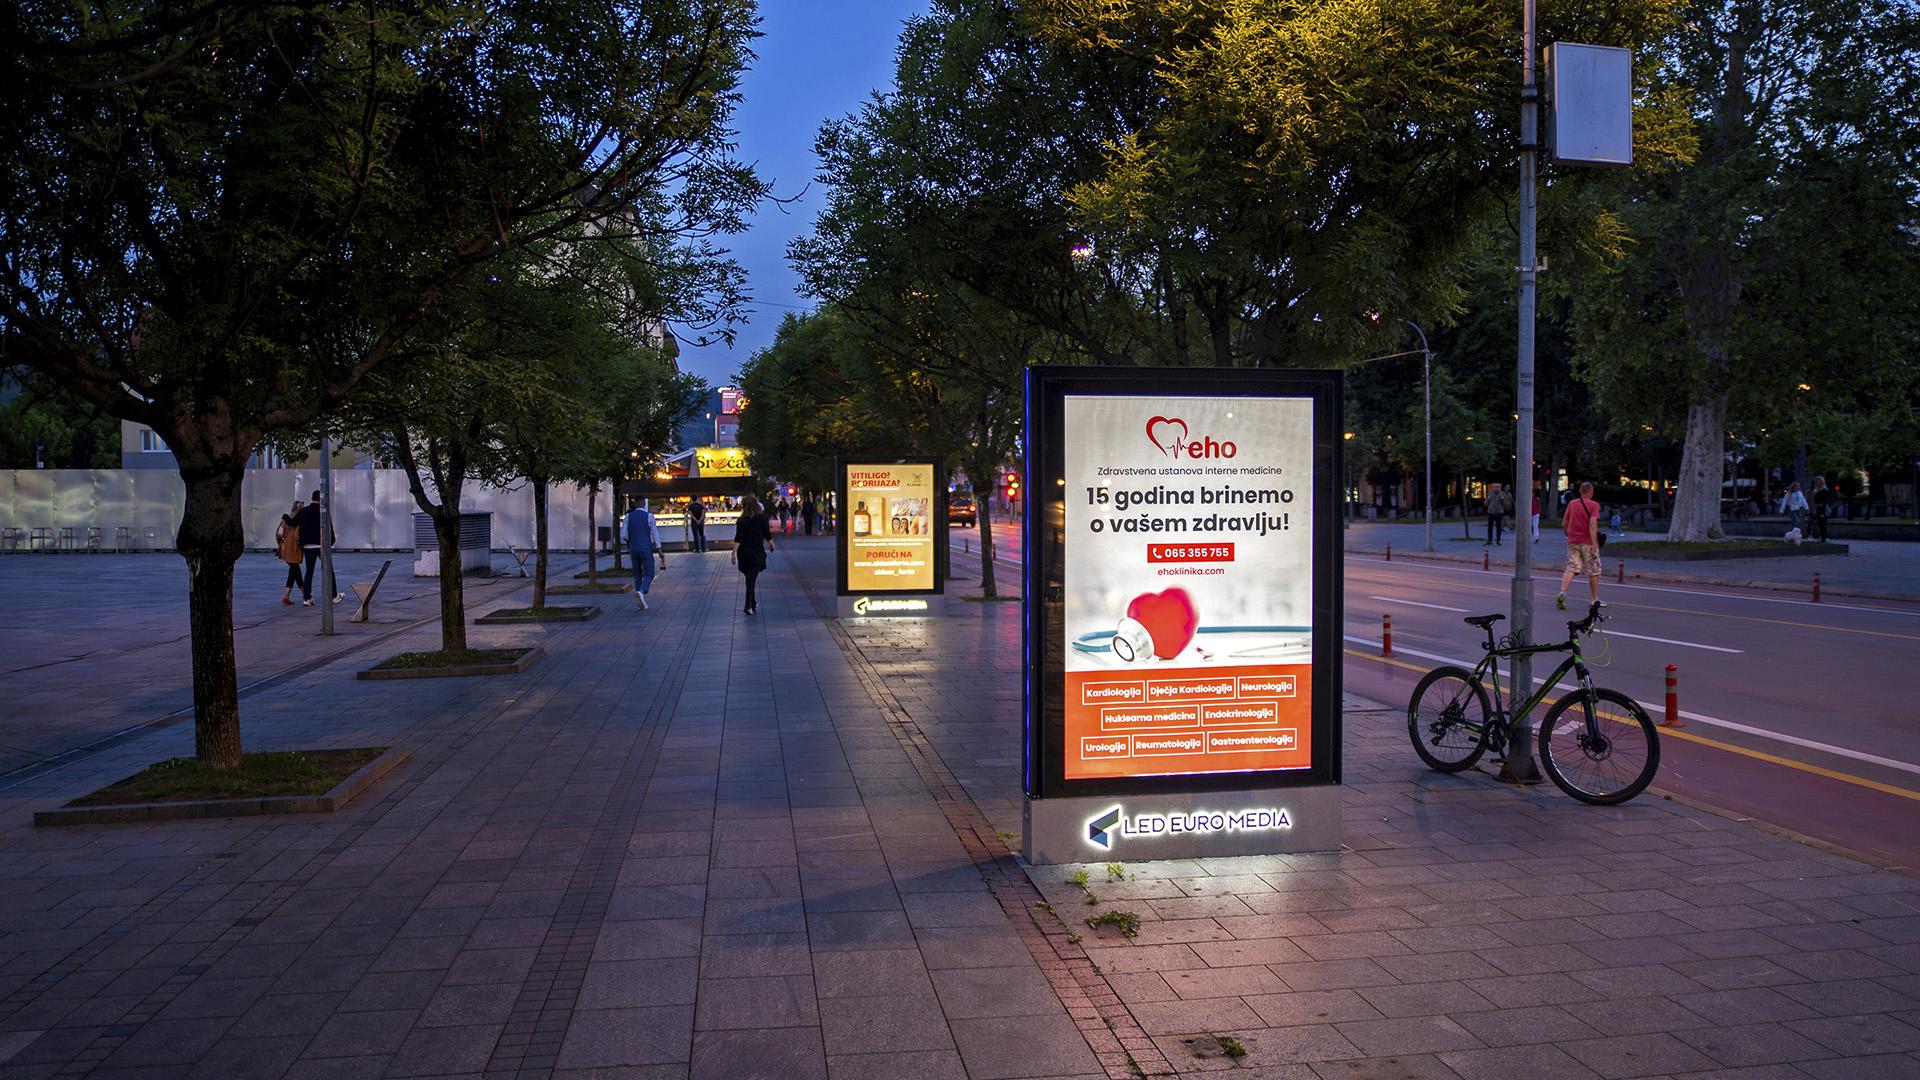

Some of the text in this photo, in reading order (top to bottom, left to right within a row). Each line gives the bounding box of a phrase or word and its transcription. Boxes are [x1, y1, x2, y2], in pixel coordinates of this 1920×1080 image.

[1188, 436, 1236, 458] eho
[1098, 466, 1282, 476] Zdravstvena ustanova interne medicine
[1086, 485, 1294, 511] 15 godina brinemo
[1090, 512, 1289, 536] o vašem zdravlju!
[866, 550, 898, 558] PORUČI
[1164, 548, 1229, 558] 065 355 755
[1158, 567, 1224, 576] ehoklinika.com
[1150, 684, 1233, 696] Dječja Kardiologija
[1241, 682, 1292, 692] Neurologija
[1086, 688, 1142, 698] Kardiologija
[1105, 712, 1196, 723] Nuklearna medicina
[1205, 708, 1273, 719] Endokrinologija
[1136, 739, 1201, 750] Reumatologija
[1211, 735, 1293, 746] Gastroenterologija
[1086, 742, 1126, 753] Urologija
[1124, 812, 1290, 834] LED EURO MEDIA
